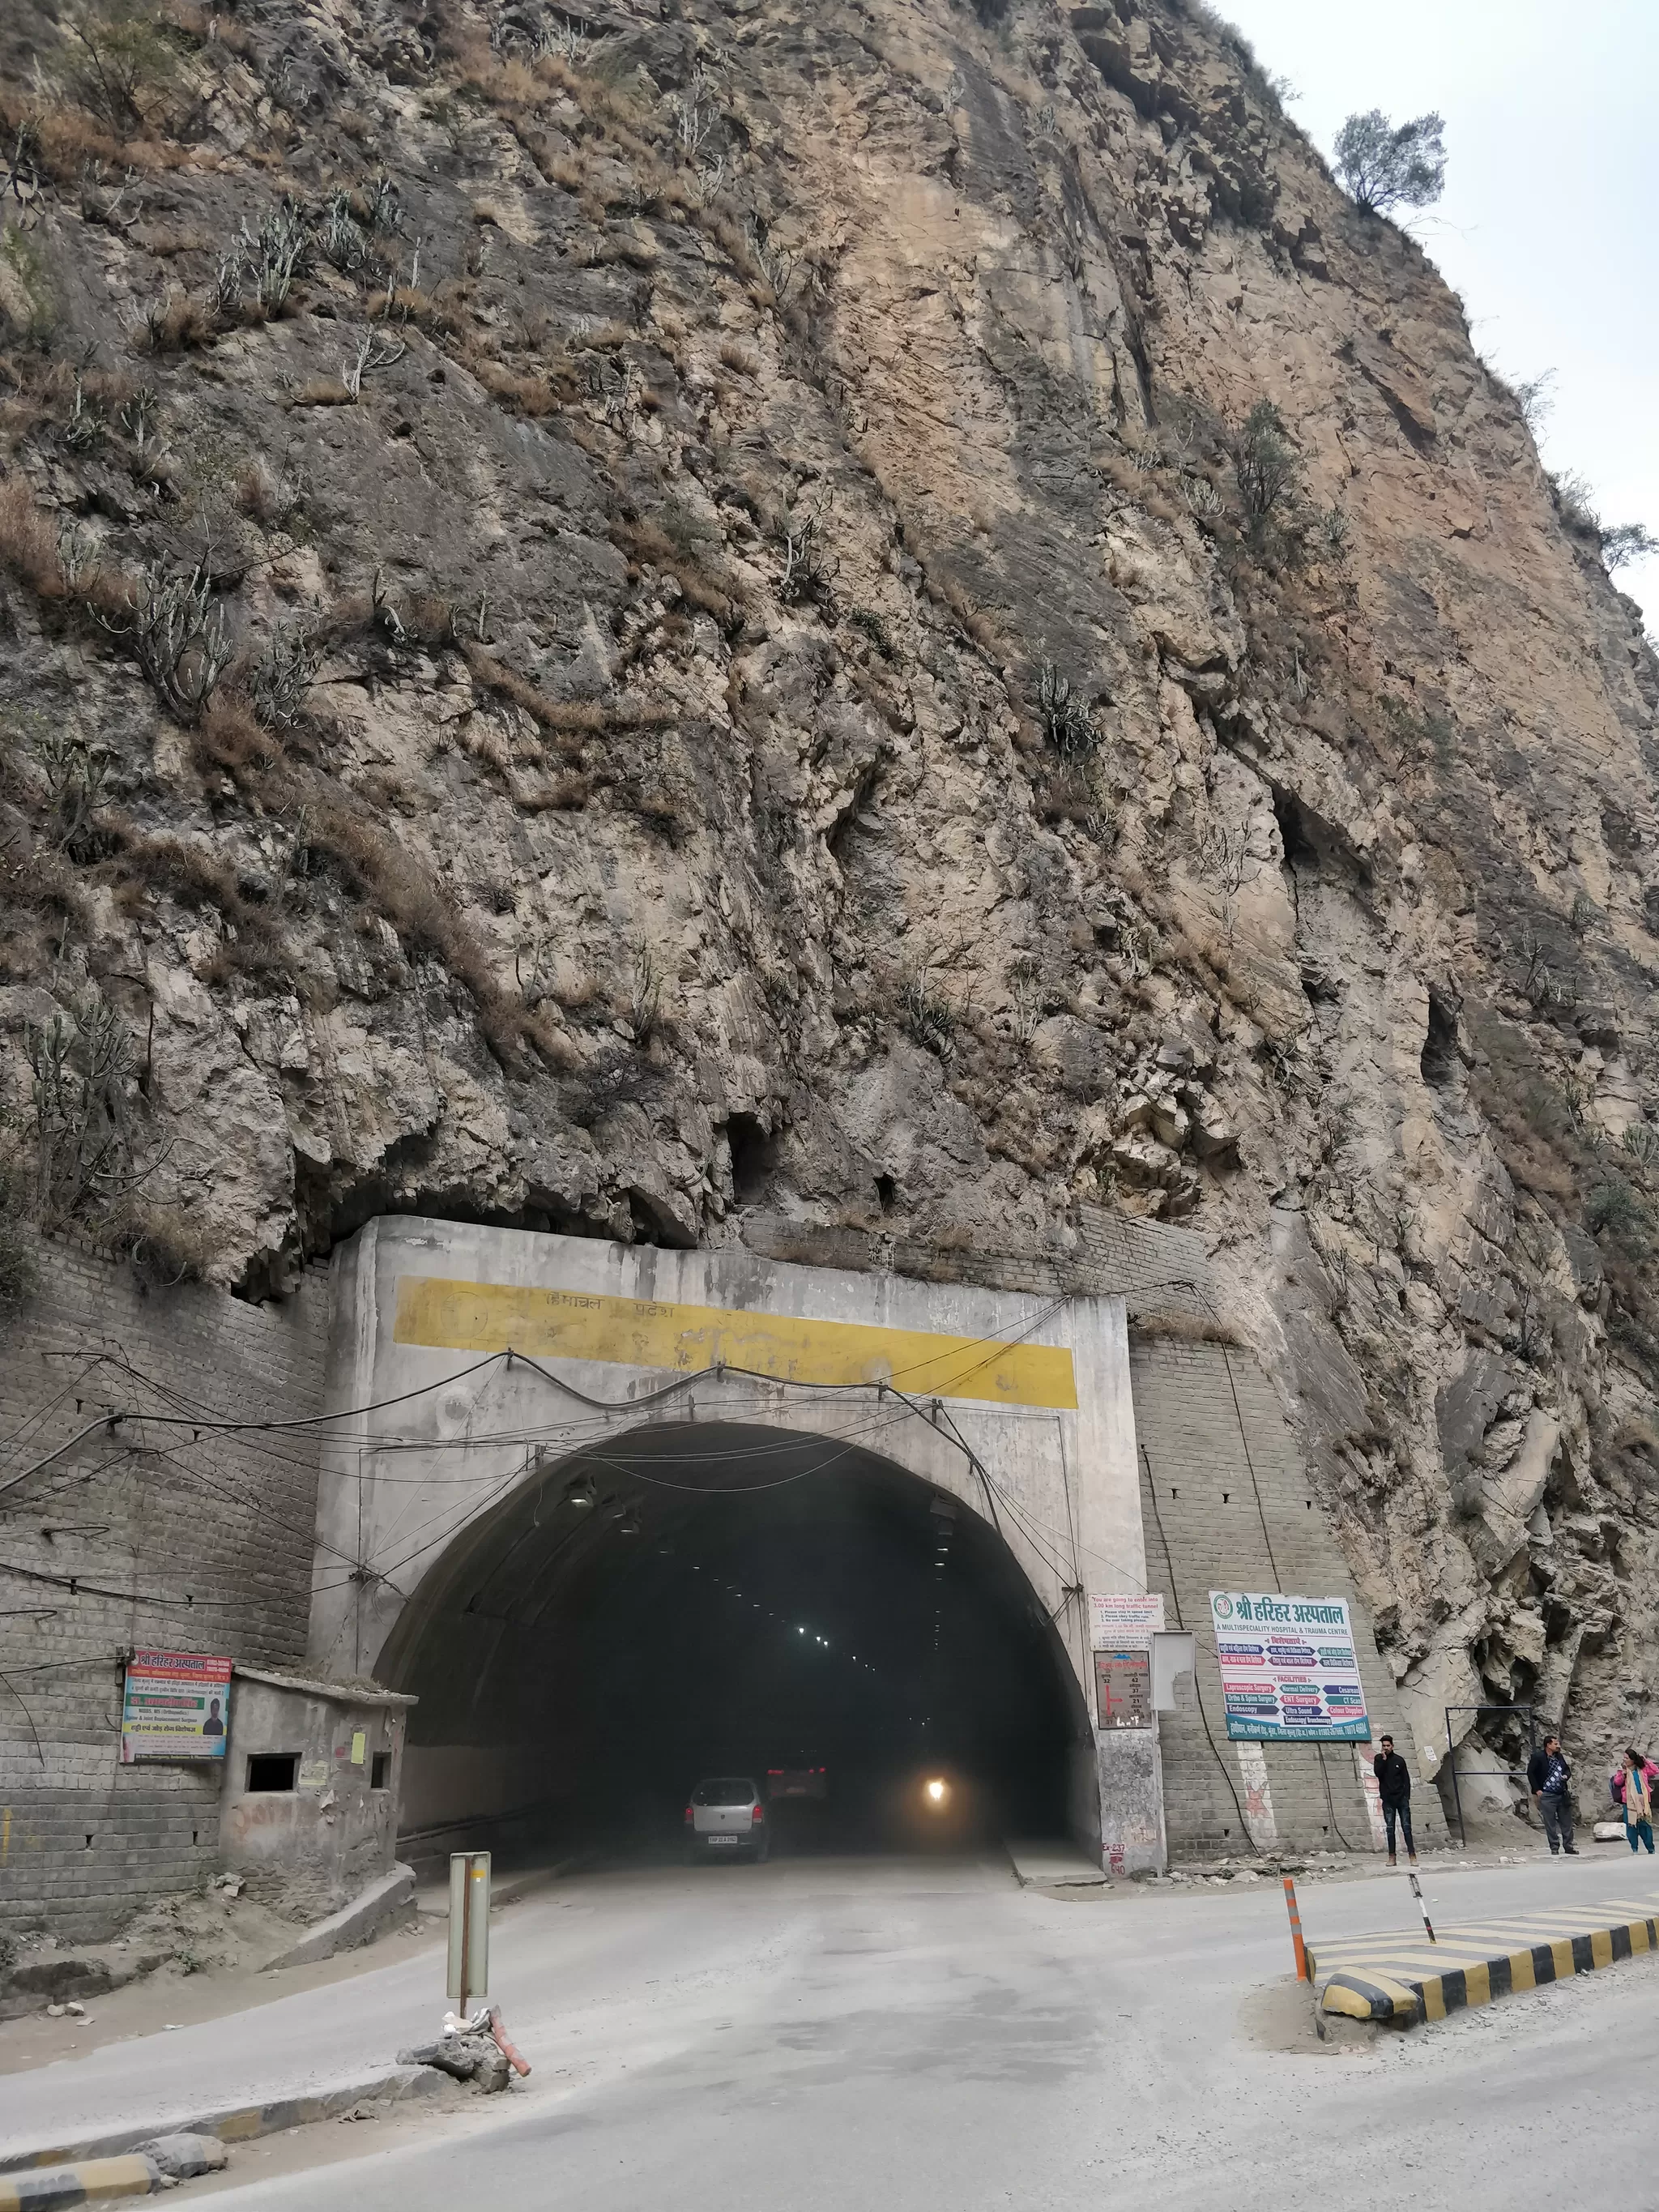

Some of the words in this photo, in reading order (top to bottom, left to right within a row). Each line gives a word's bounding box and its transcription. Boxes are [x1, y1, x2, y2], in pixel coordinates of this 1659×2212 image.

[1236, 1595, 1252, 1621] श्री
[1253, 1596, 1290, 1622] हरिहर
[1292, 1604, 1345, 1624] अस्पताल
[140, 1653, 150, 1666] श्री
[151, 1654, 173, 1668] हरिहर
[174, 1659, 205, 1670] अस्पताल
[1226, 1684, 1253, 1692] Laproscopic
[1254, 1685, 1272, 1693] Surgery
[1259, 1695, 1275, 1703] Surgery
[1296, 1696, 1316, 1704] Surgery
[142, 1723, 151, 1732] एवं
[1111, 1865, 1125, 1875] 640
